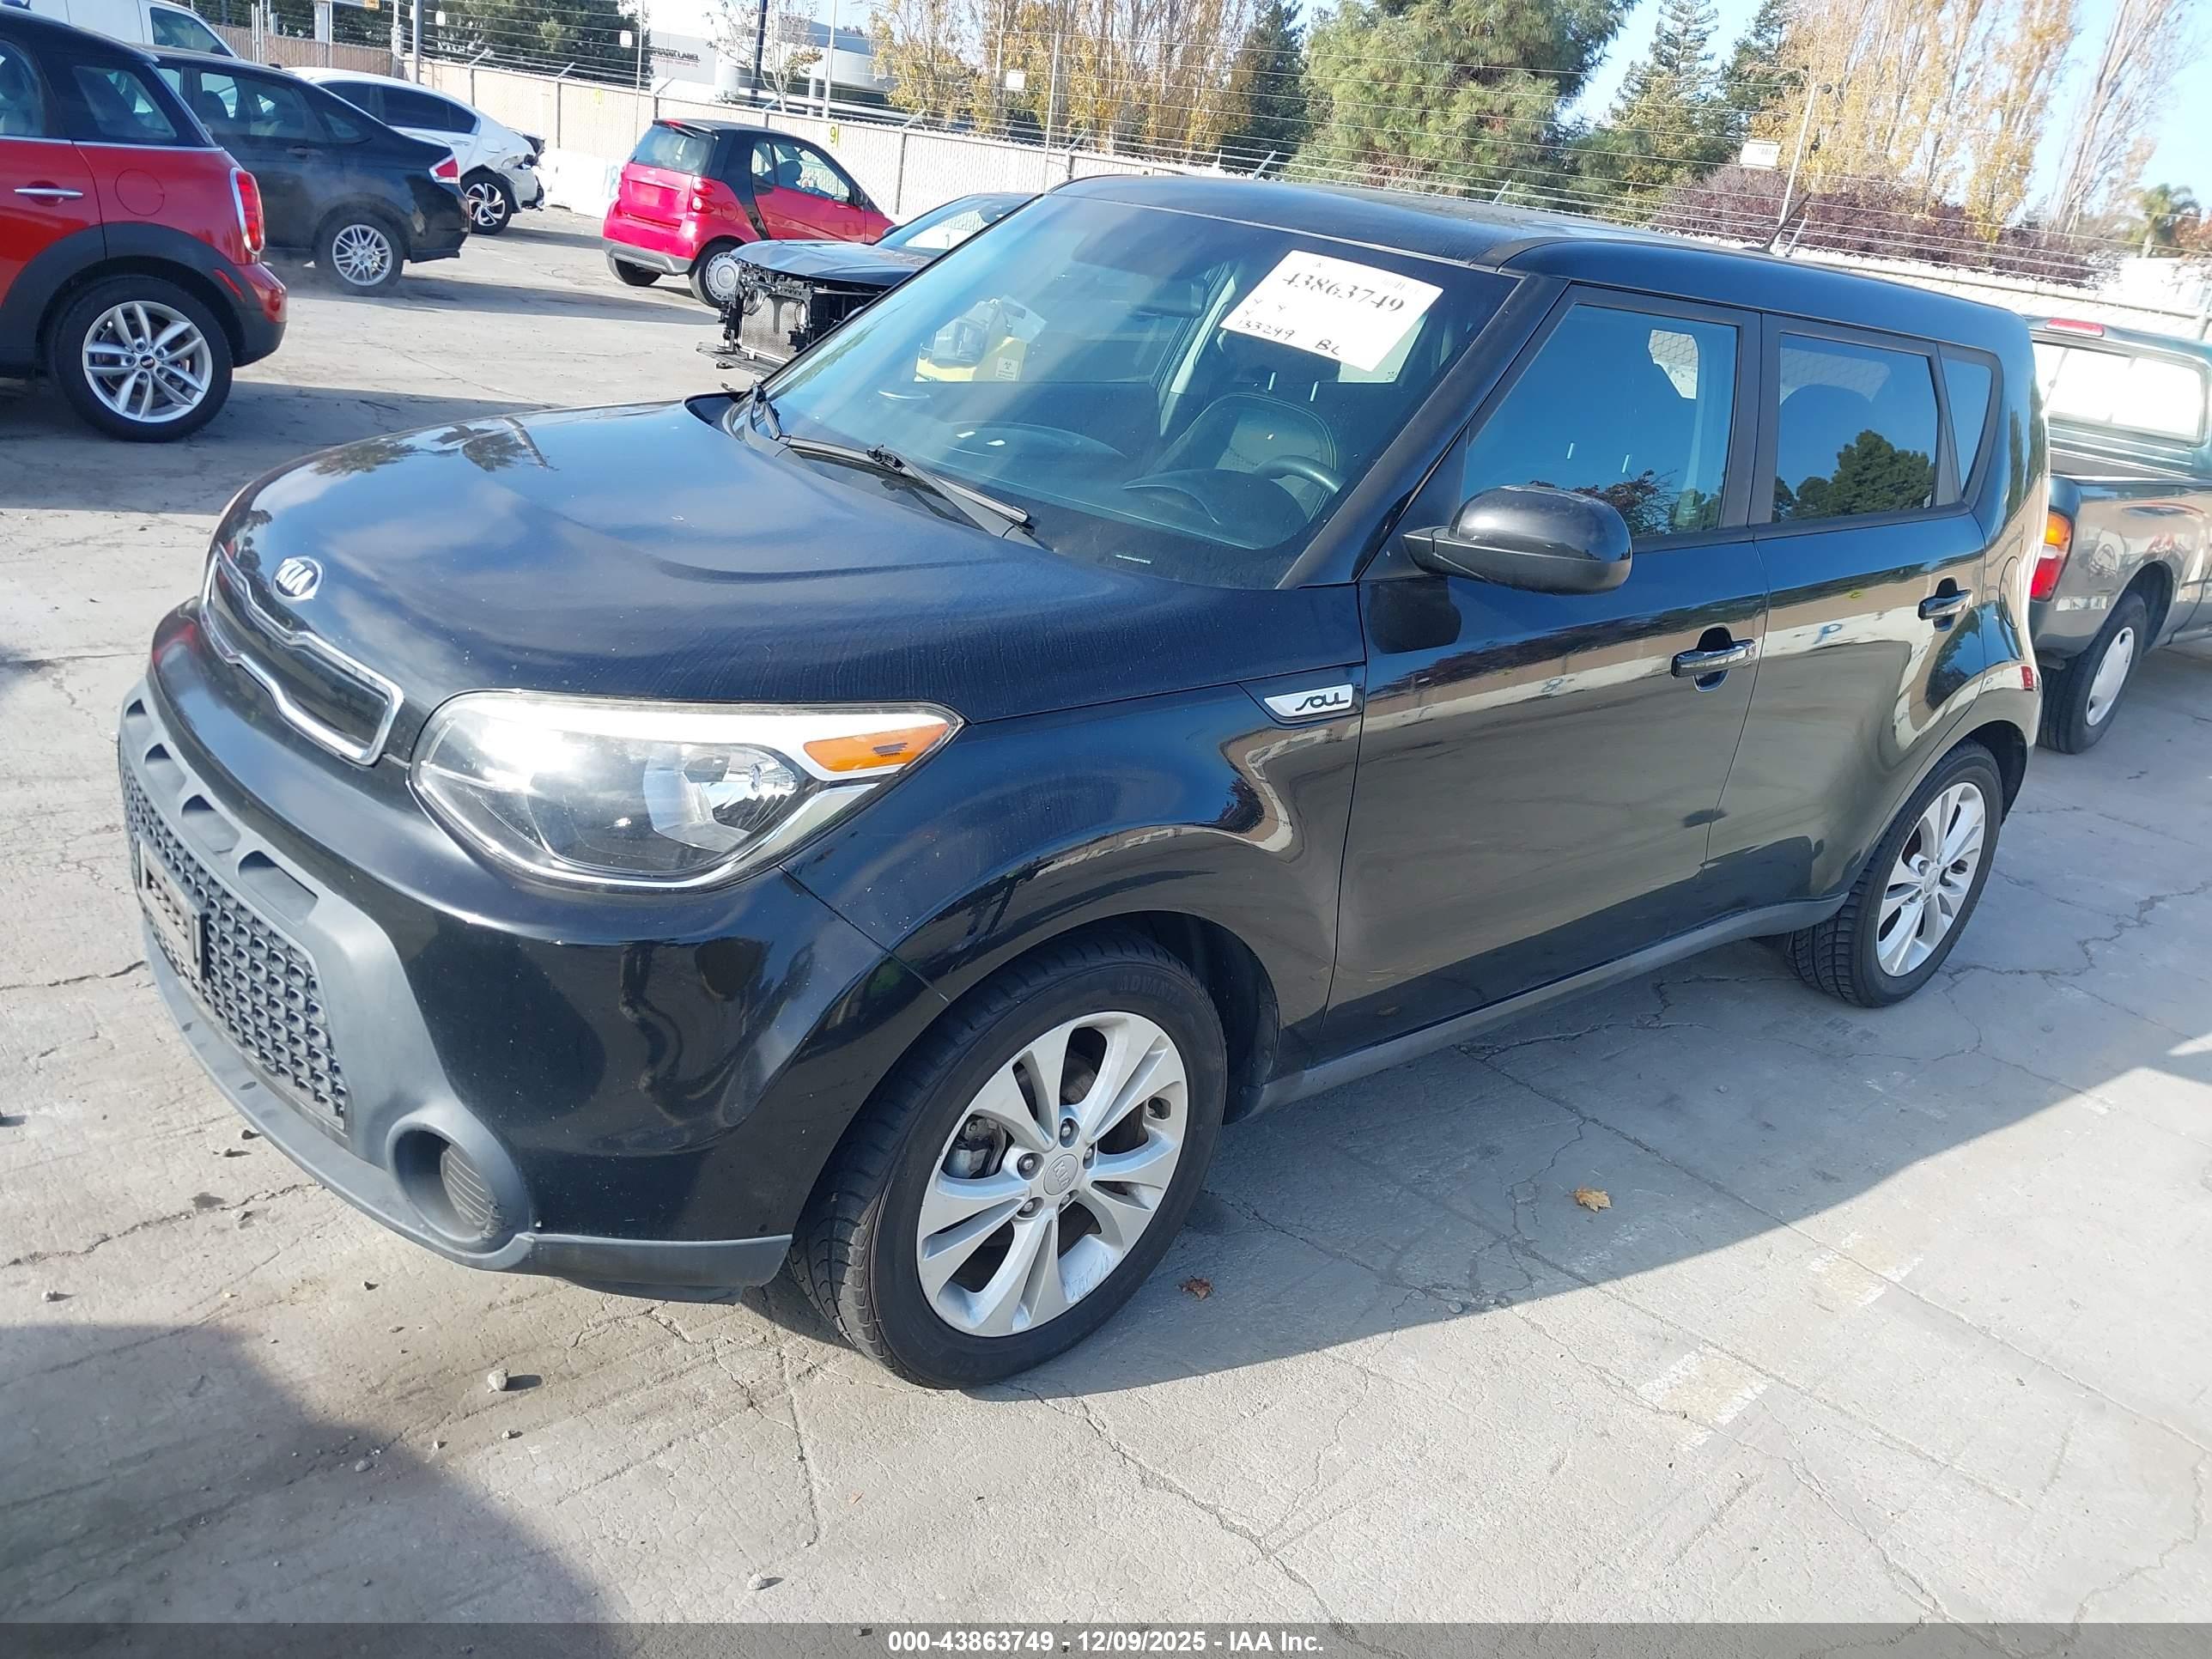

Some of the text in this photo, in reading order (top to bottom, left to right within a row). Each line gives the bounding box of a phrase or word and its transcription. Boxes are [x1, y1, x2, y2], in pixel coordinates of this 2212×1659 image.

[830, 126, 836, 143] 9
[1283, 272, 1405, 312] 43863749
[1295, 692, 1349, 712] SOUL
[1053, 1160, 1072, 1188] KIA
